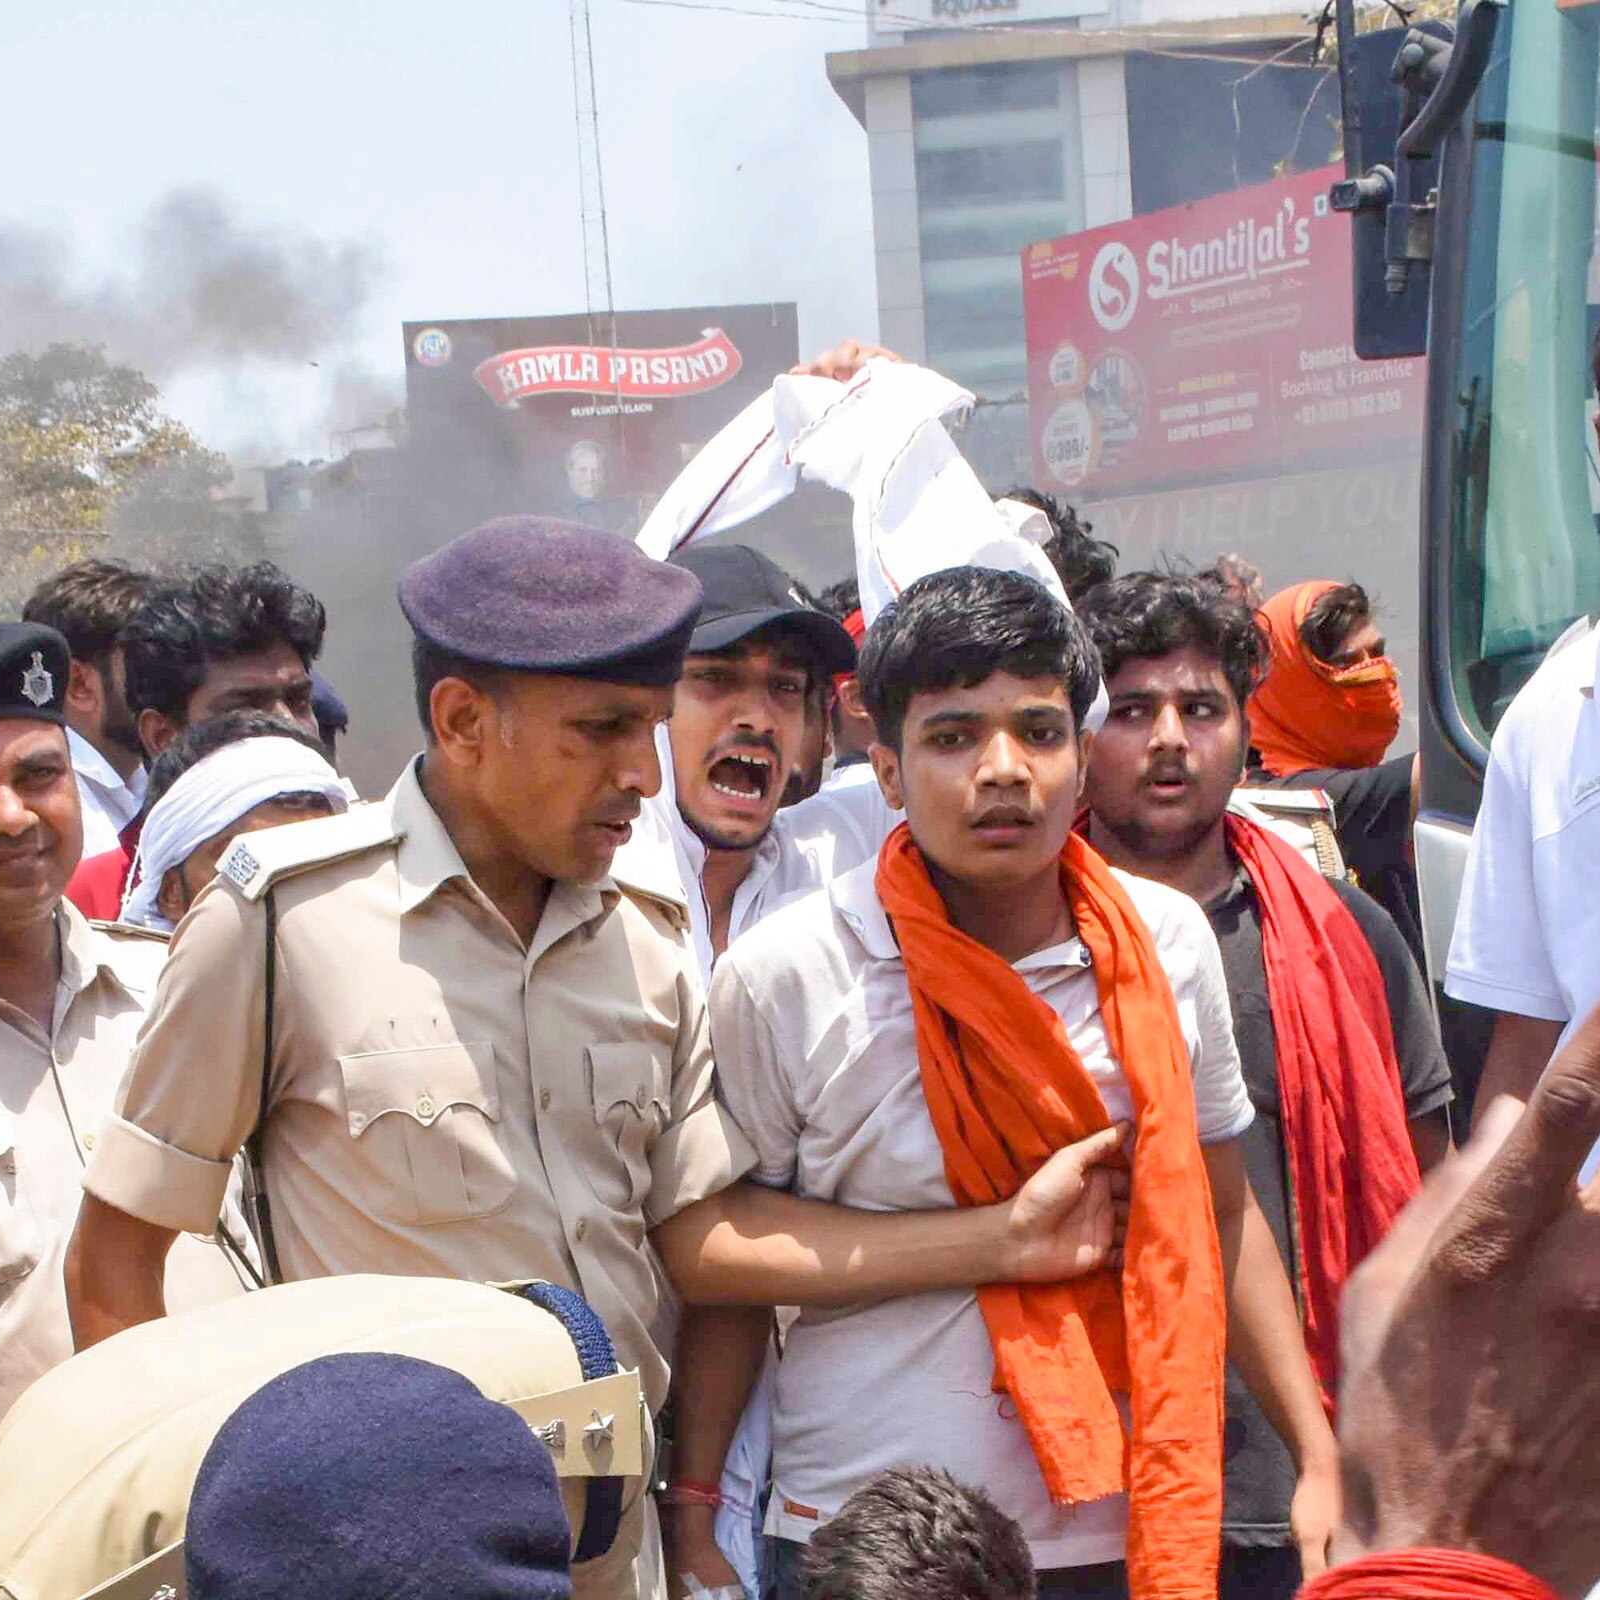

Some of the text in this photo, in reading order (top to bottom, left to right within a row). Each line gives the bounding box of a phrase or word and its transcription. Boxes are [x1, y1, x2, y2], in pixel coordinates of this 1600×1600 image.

[1146, 197, 1310, 299] Shantilal's
[497, 347, 728, 396] KAMLA PASAND
[1280, 359, 1414, 399] Booking & Franchise
